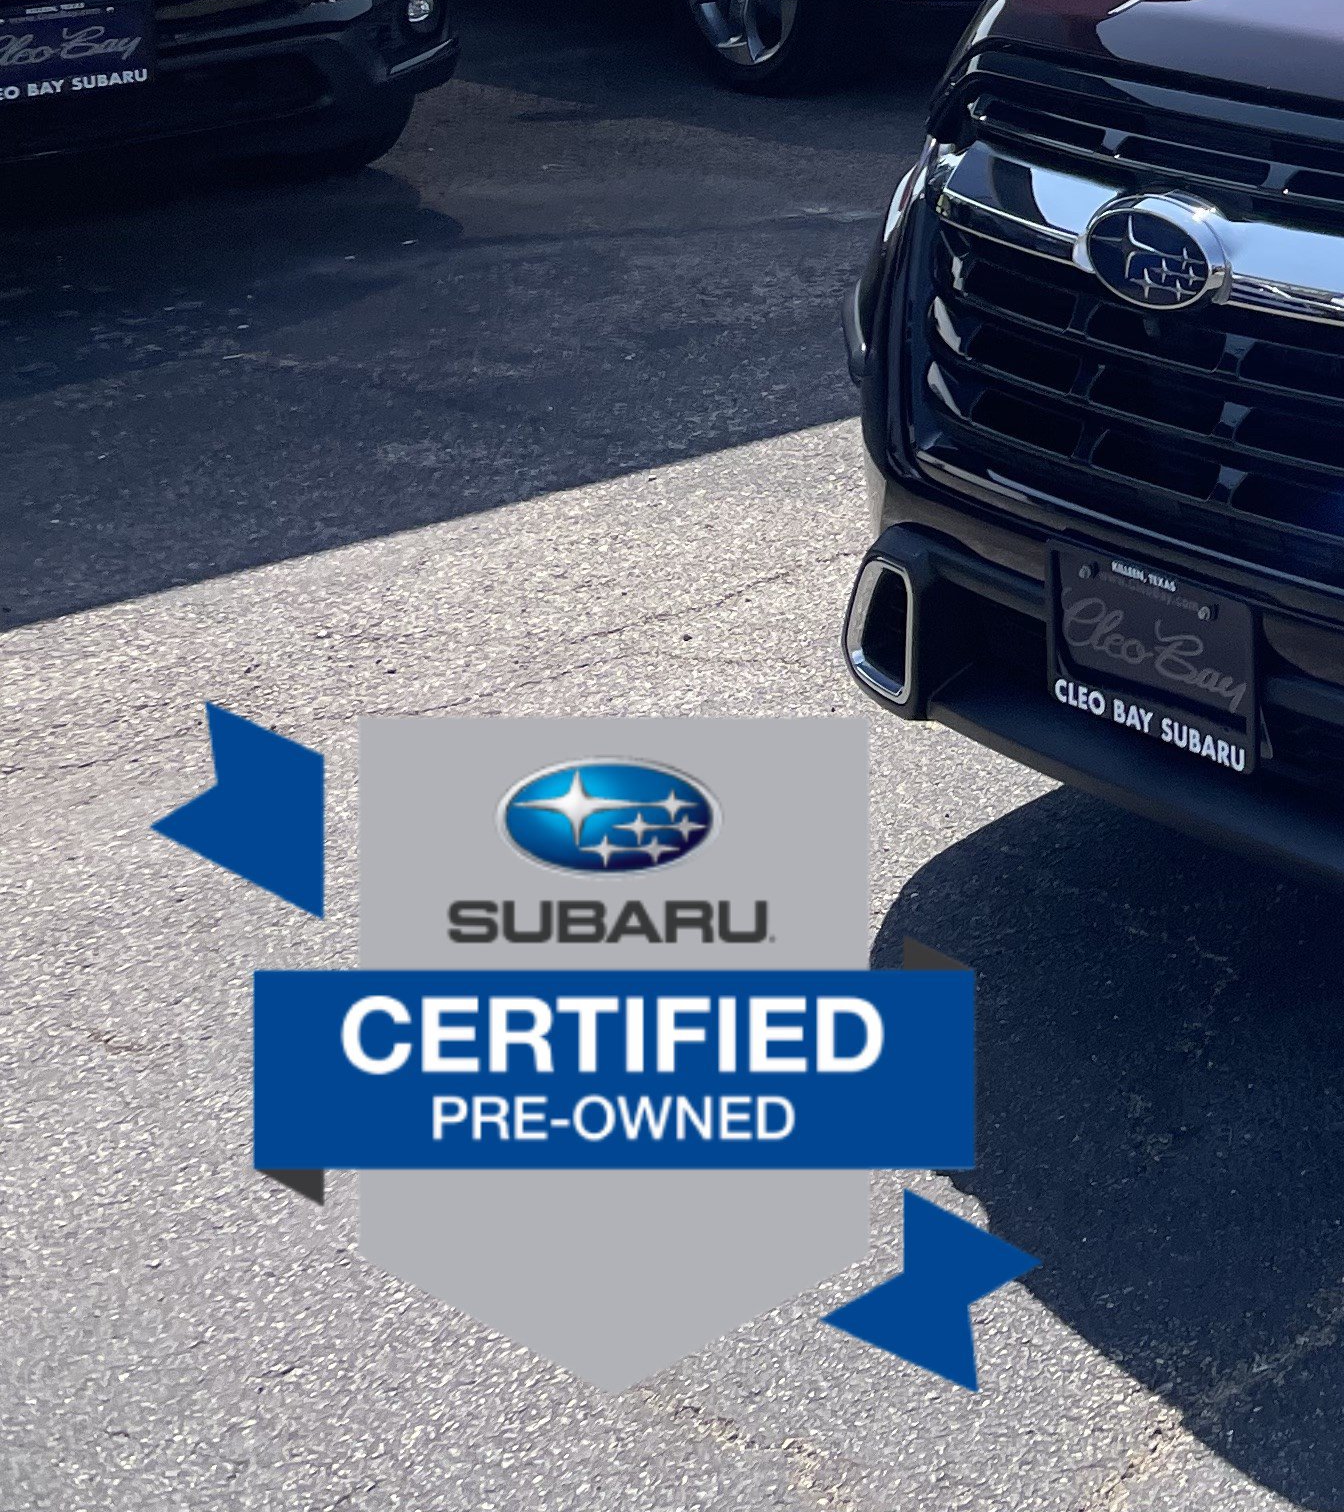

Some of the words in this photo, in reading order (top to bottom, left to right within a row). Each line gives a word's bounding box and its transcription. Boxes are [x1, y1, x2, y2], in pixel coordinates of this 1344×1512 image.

[27, 79, 64, 97] BAY
[71, 68, 148, 91] SUBARU
[1147, 573, 1177, 593] TEXAS
[1061, 586, 1154, 666] Cleo
[1154, 618, 1247, 713] Bay
[1054, 678, 1106, 717] CLEO
[1112, 698, 1154, 734] BAY
[1160, 716, 1246, 773] SUBARU
